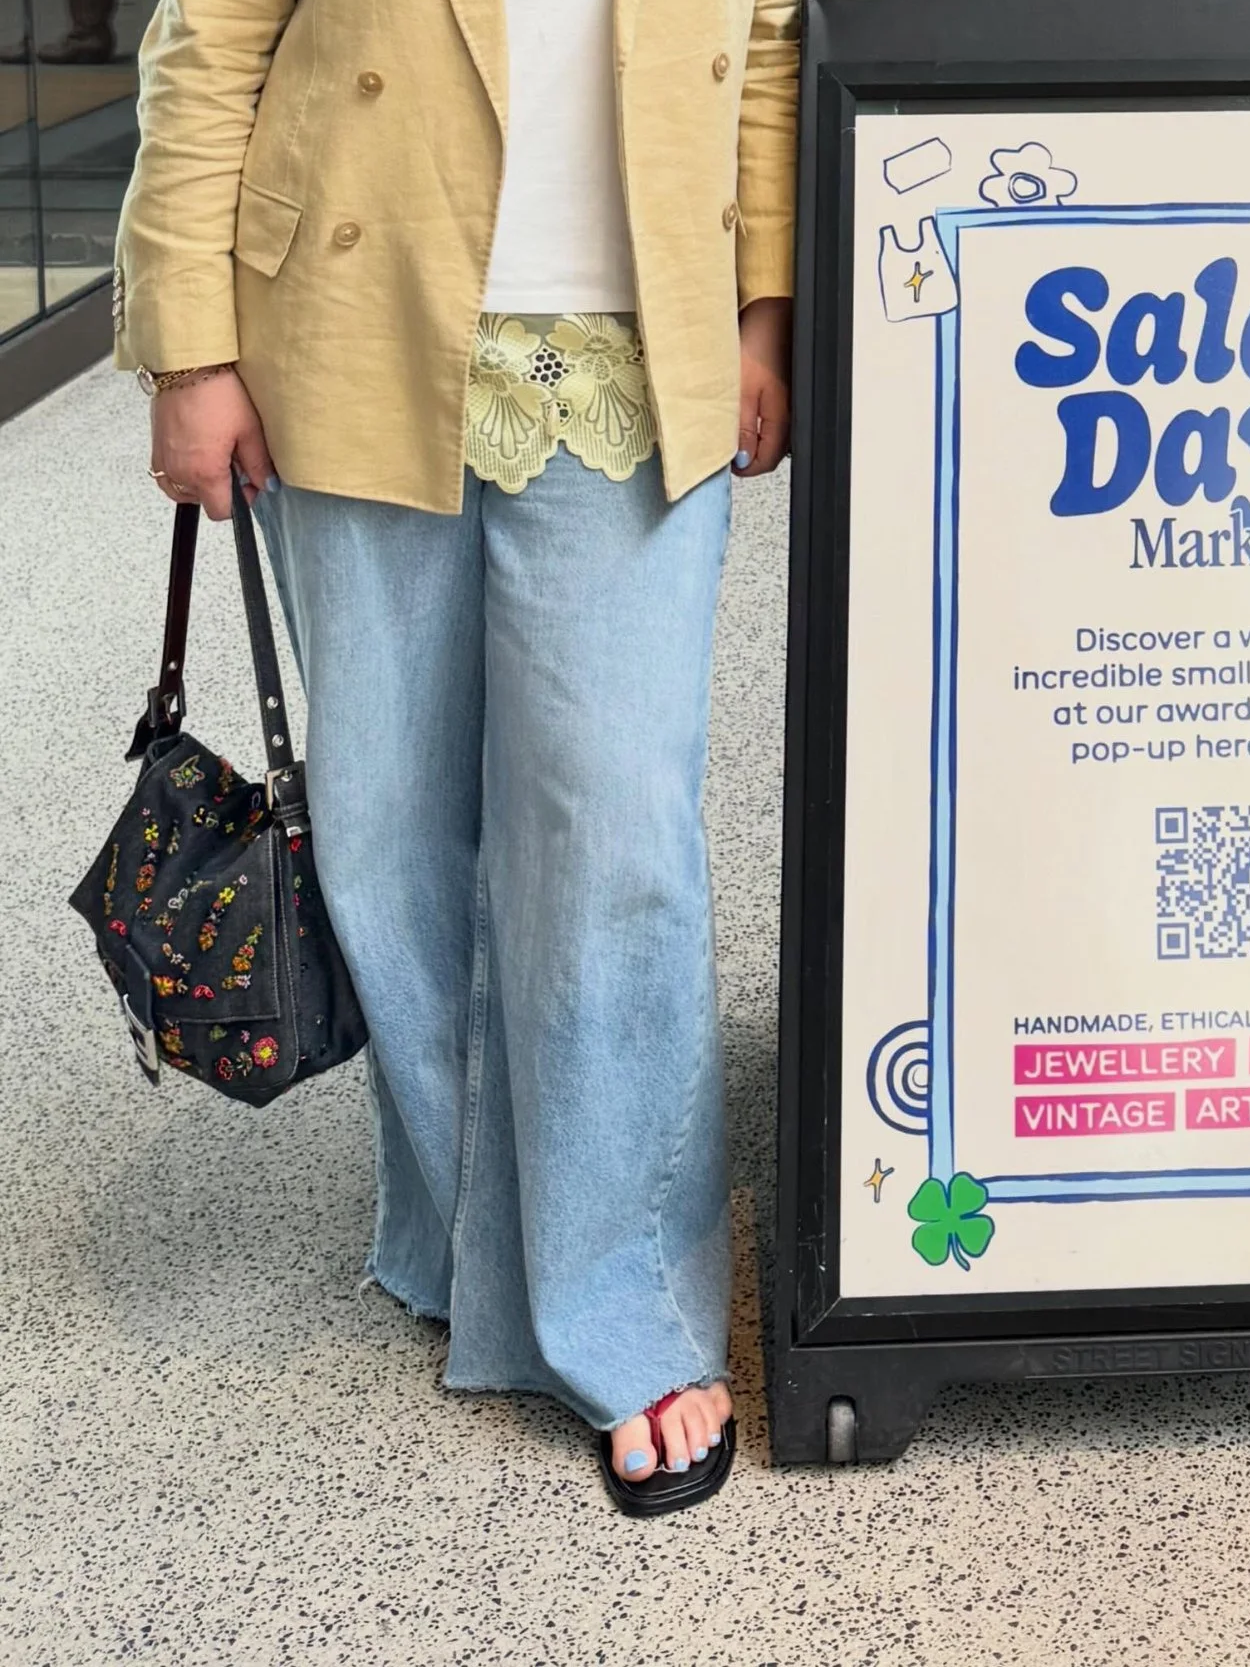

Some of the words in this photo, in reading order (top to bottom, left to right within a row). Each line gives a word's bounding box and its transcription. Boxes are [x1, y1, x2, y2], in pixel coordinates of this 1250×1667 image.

[1076, 627, 1206, 652] Discover
[1213, 630, 1231, 649] a
[1013, 662, 1162, 690] incredible
[1172, 660, 1250, 686] small
[1053, 701, 1086, 725] at
[1096, 704, 1148, 724] our
[1072, 738, 1186, 764] pop-up
[1013, 1013, 1154, 1034] HANDMADE,
[1023, 1045, 1225, 1079] JEWELLERY
[1022, 1099, 1165, 1130] VINTAGE
[1052, 1344, 1170, 1372] STREET
